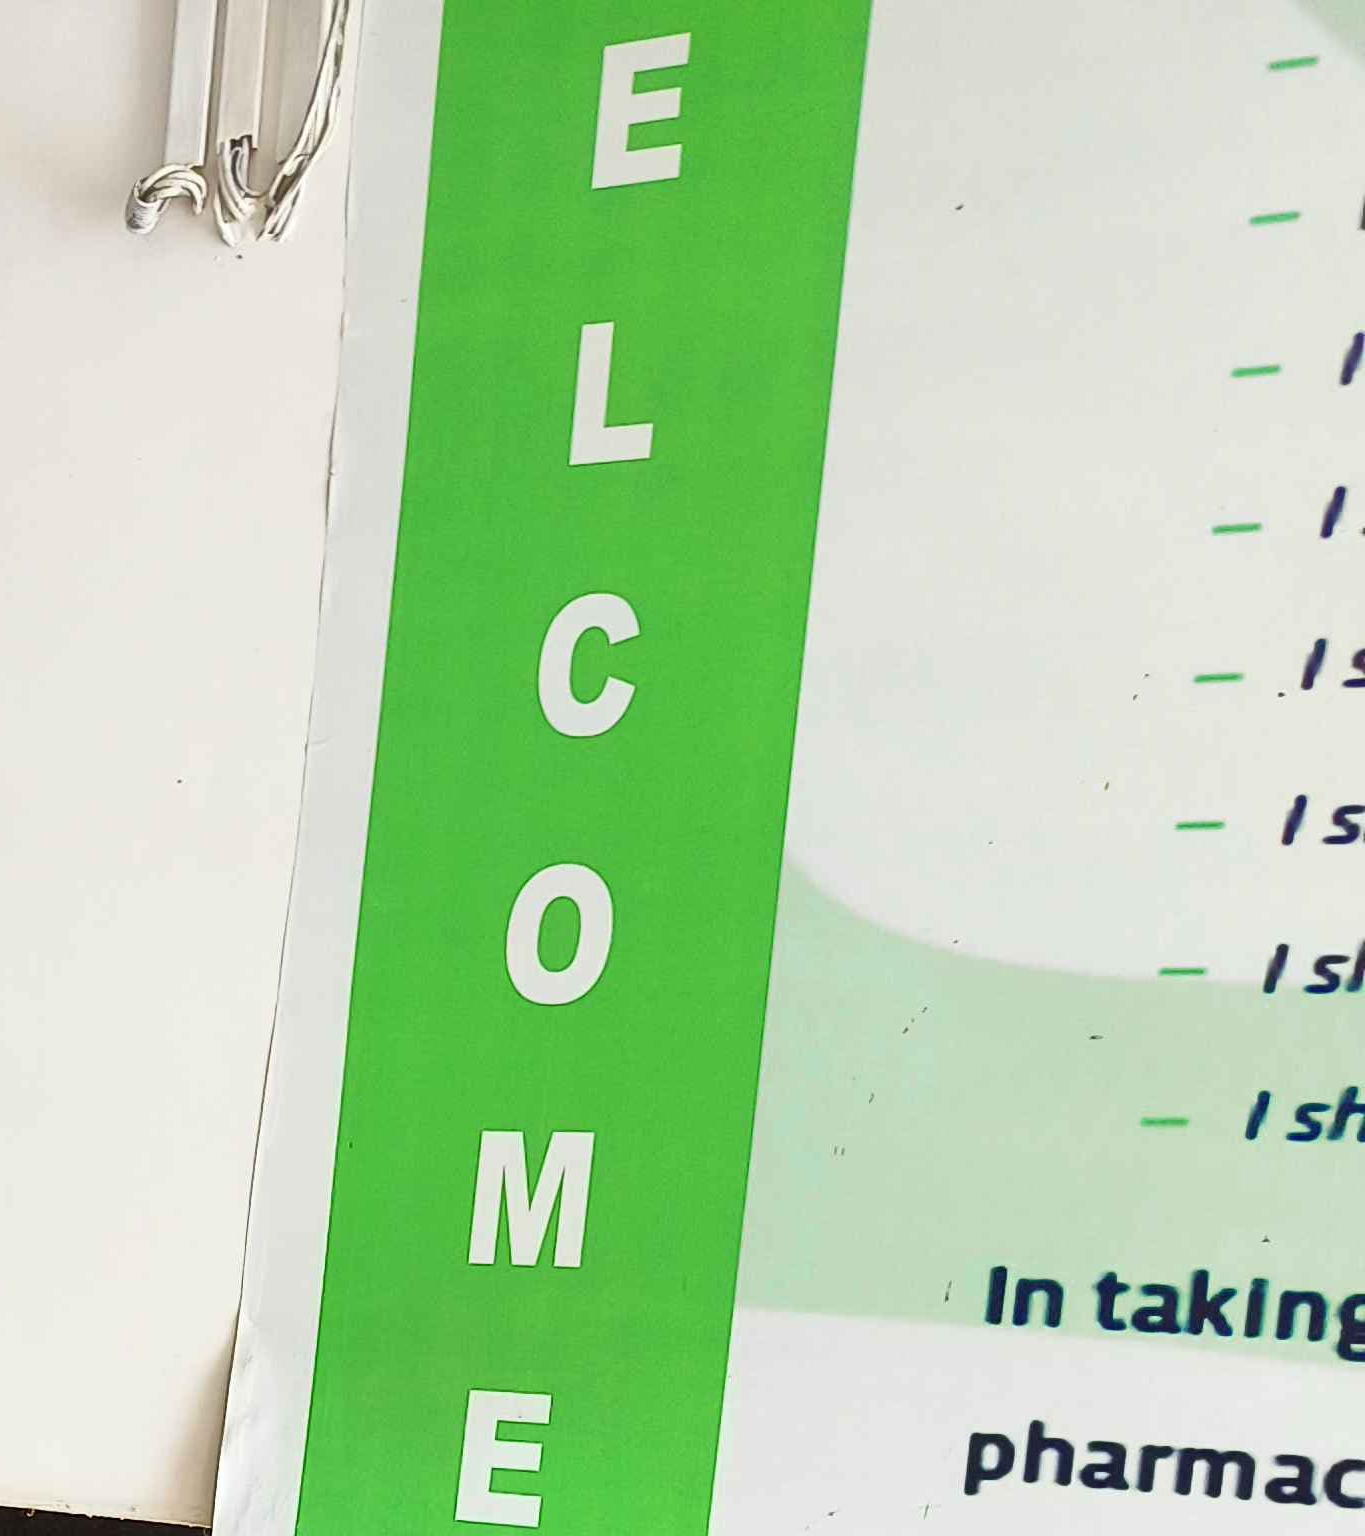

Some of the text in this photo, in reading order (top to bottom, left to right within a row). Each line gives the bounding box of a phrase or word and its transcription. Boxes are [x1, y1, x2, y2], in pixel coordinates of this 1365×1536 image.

[1320, 485, 1346, 538] I
[1301, 637, 1327, 690] I
[1281, 794, 1307, 845] I
[1263, 943, 1288, 994] I
[1245, 1090, 1270, 1140] I
[985, 1265, 1365, 1362] In taking
[964, 1419, 1365, 1509] pharmac
